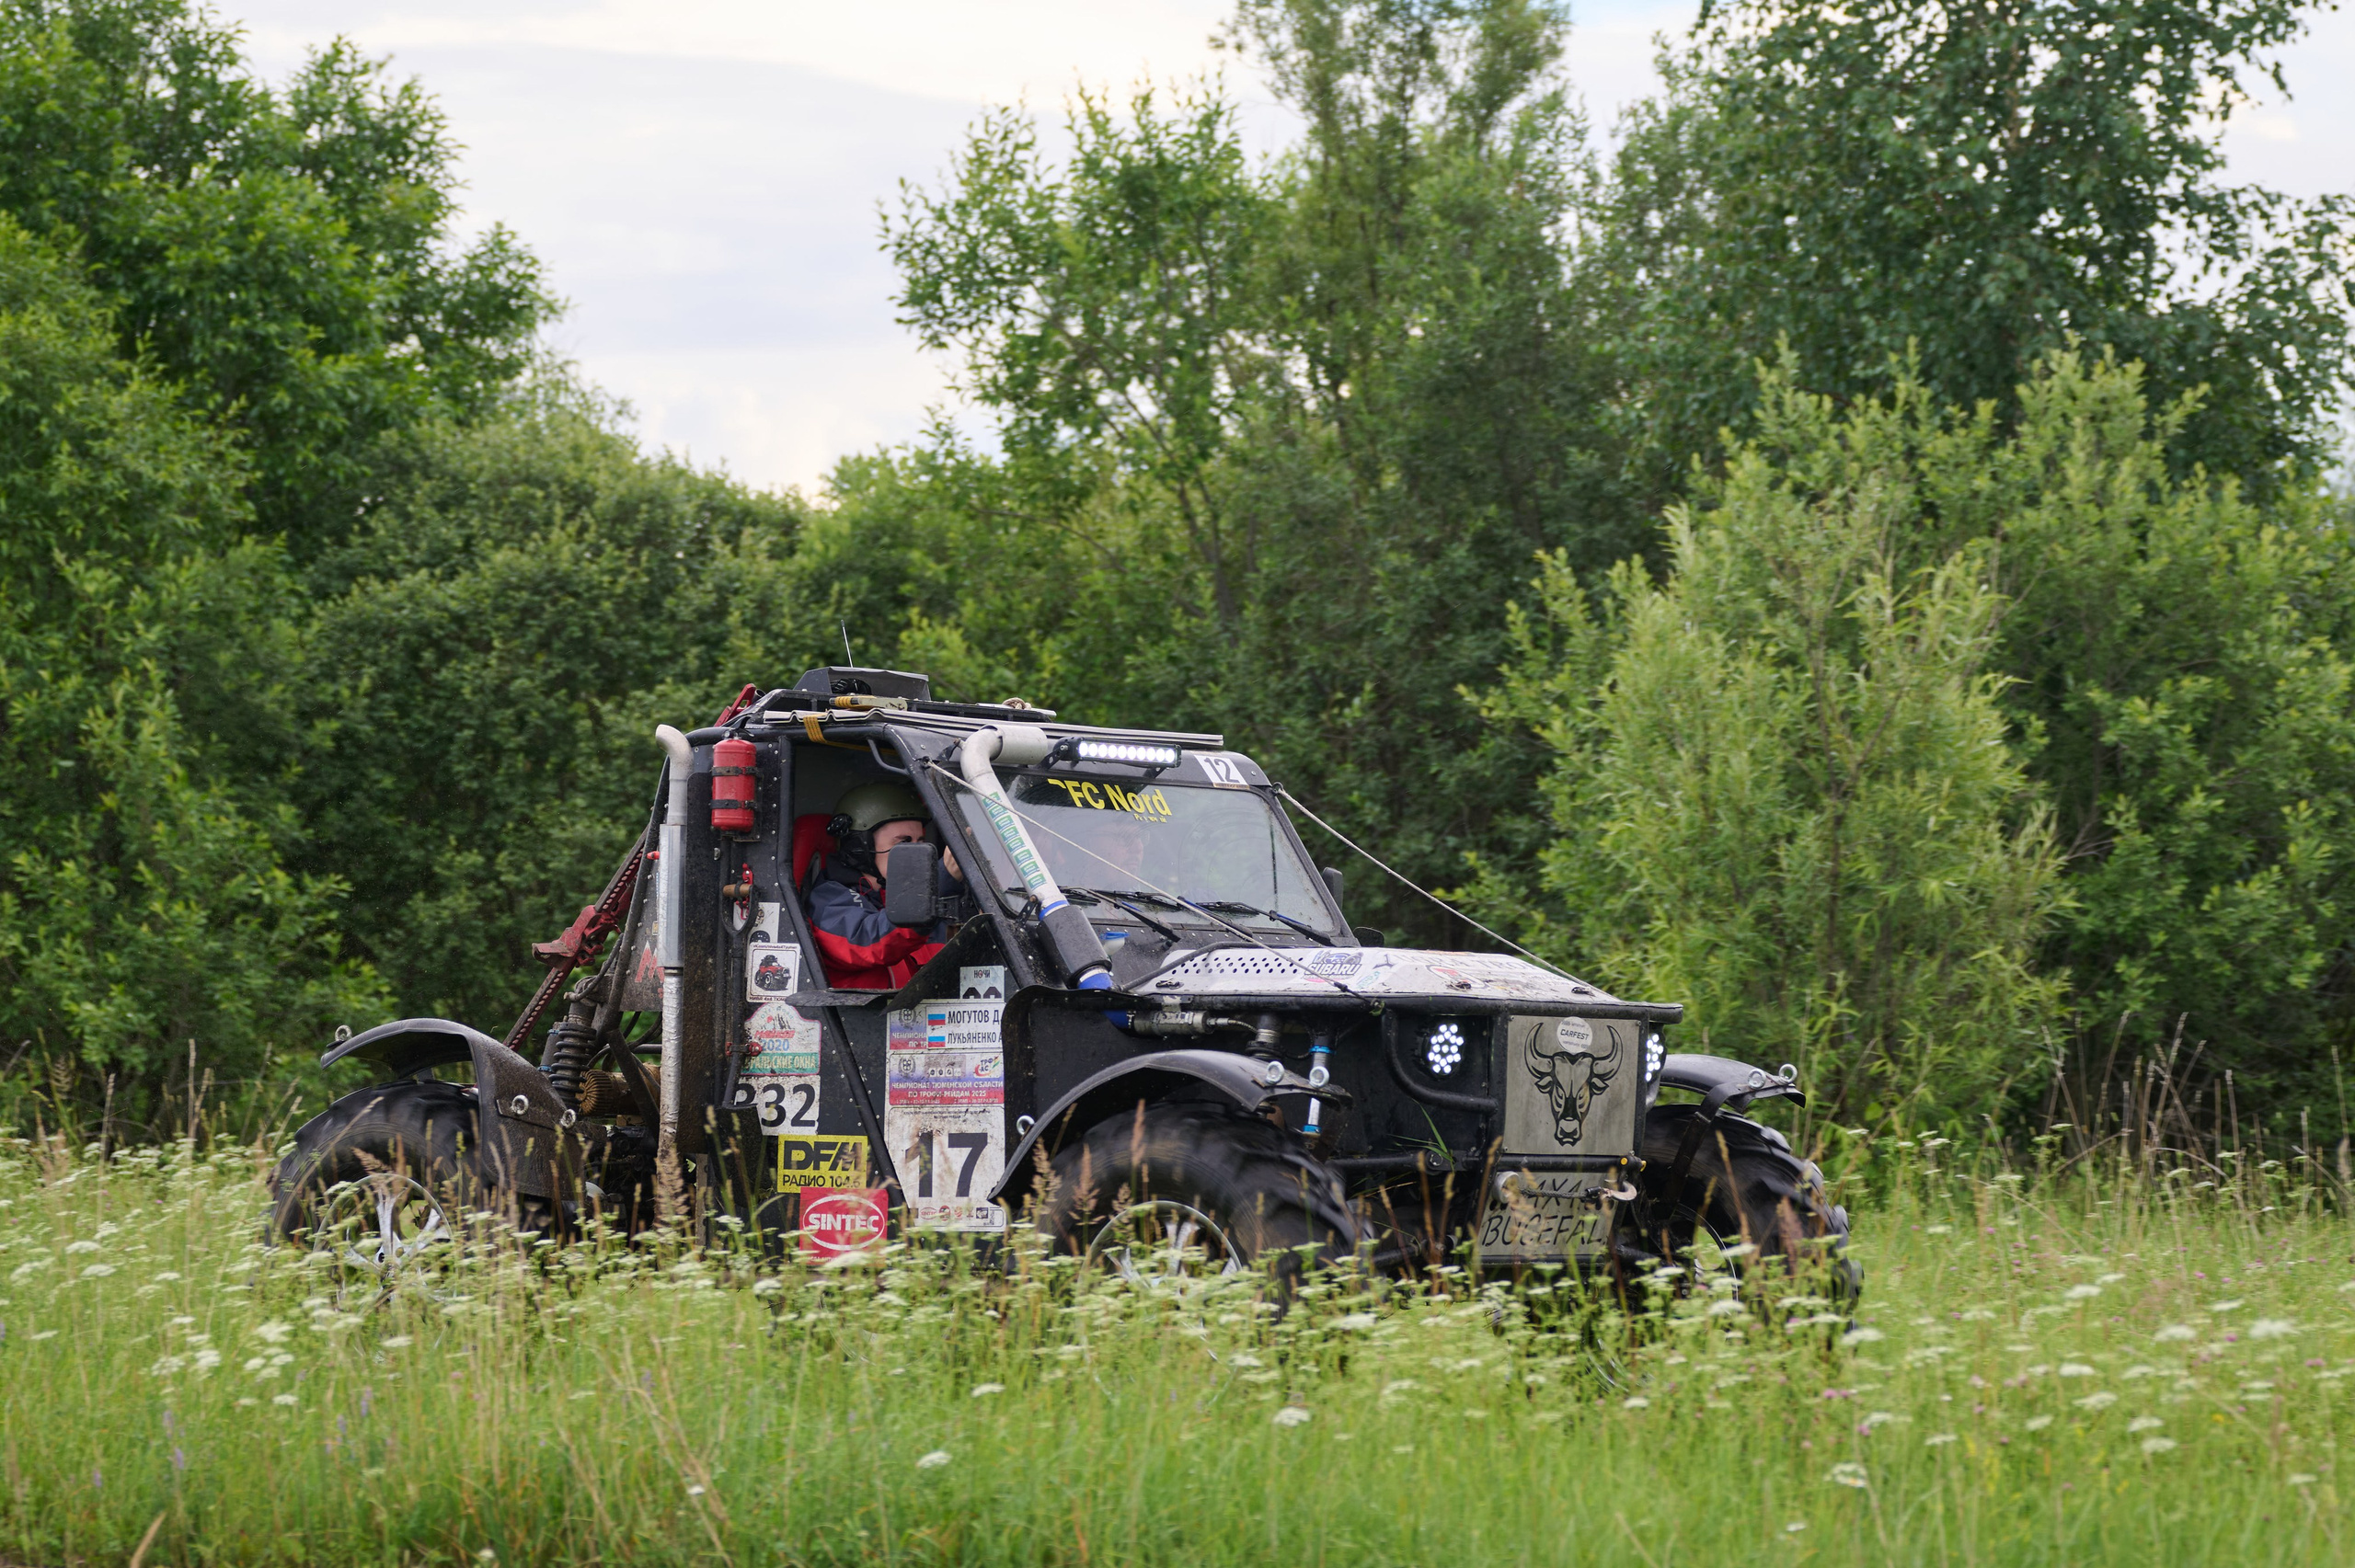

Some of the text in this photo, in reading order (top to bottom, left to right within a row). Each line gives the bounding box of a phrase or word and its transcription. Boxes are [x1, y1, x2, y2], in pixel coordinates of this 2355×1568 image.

[1203, 757, 1240, 783] 12
[1103, 784, 1172, 816] Nord
[973, 969, 991, 979] НОЧИ
[1304, 963, 1362, 976] SUBARU
[948, 1010, 990, 1024] МОГУТОВ
[948, 1033, 997, 1045] ЛУКЬЯНЕНКО
[1560, 1028, 1590, 1040] CARFEST
[761, 1038, 790, 1052] 2020
[794, 1056, 816, 1069] ОКНА
[932, 1081, 972, 1089] ТЮМЕНСКОЙ
[920, 1089, 971, 1098] ТРОФИ-РЕЙДАМ
[783, 1140, 863, 1172] DFM
[904, 1133, 989, 1198] 17
[782, 1173, 826, 1187] РАДИО
[808, 1213, 880, 1232] SINTEC
